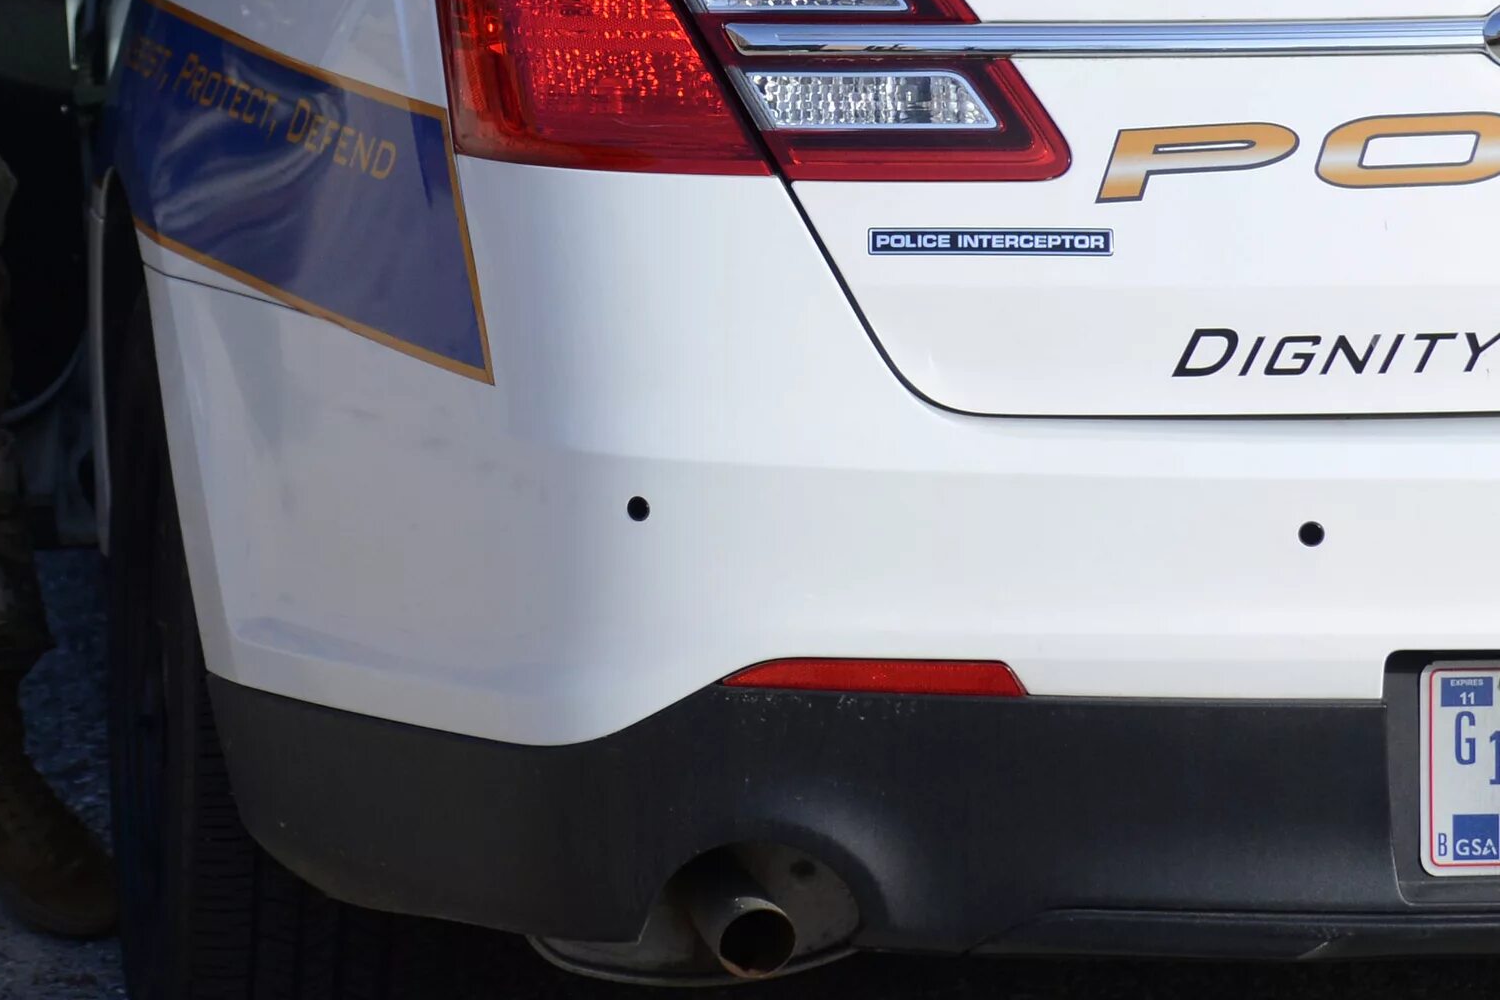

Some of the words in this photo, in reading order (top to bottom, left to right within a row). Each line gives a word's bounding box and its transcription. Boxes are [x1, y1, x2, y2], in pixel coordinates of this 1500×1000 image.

[173, 53, 279, 143] PROTECT,
[286, 97, 397, 180] DEFEND
[1095, 111, 1500, 203] PO
[875, 233, 950, 249] POLICE
[957, 233, 1106, 249] INTERCEPTOR
[1171, 328, 1500, 377] DIGNITY
[1450, 678, 1484, 687] EXPIRES
[1459, 692, 1476, 705] 11
[1454, 710, 1477, 766] G
[1437, 832, 1448, 857] B
[1455, 838, 1498, 856] GSA
